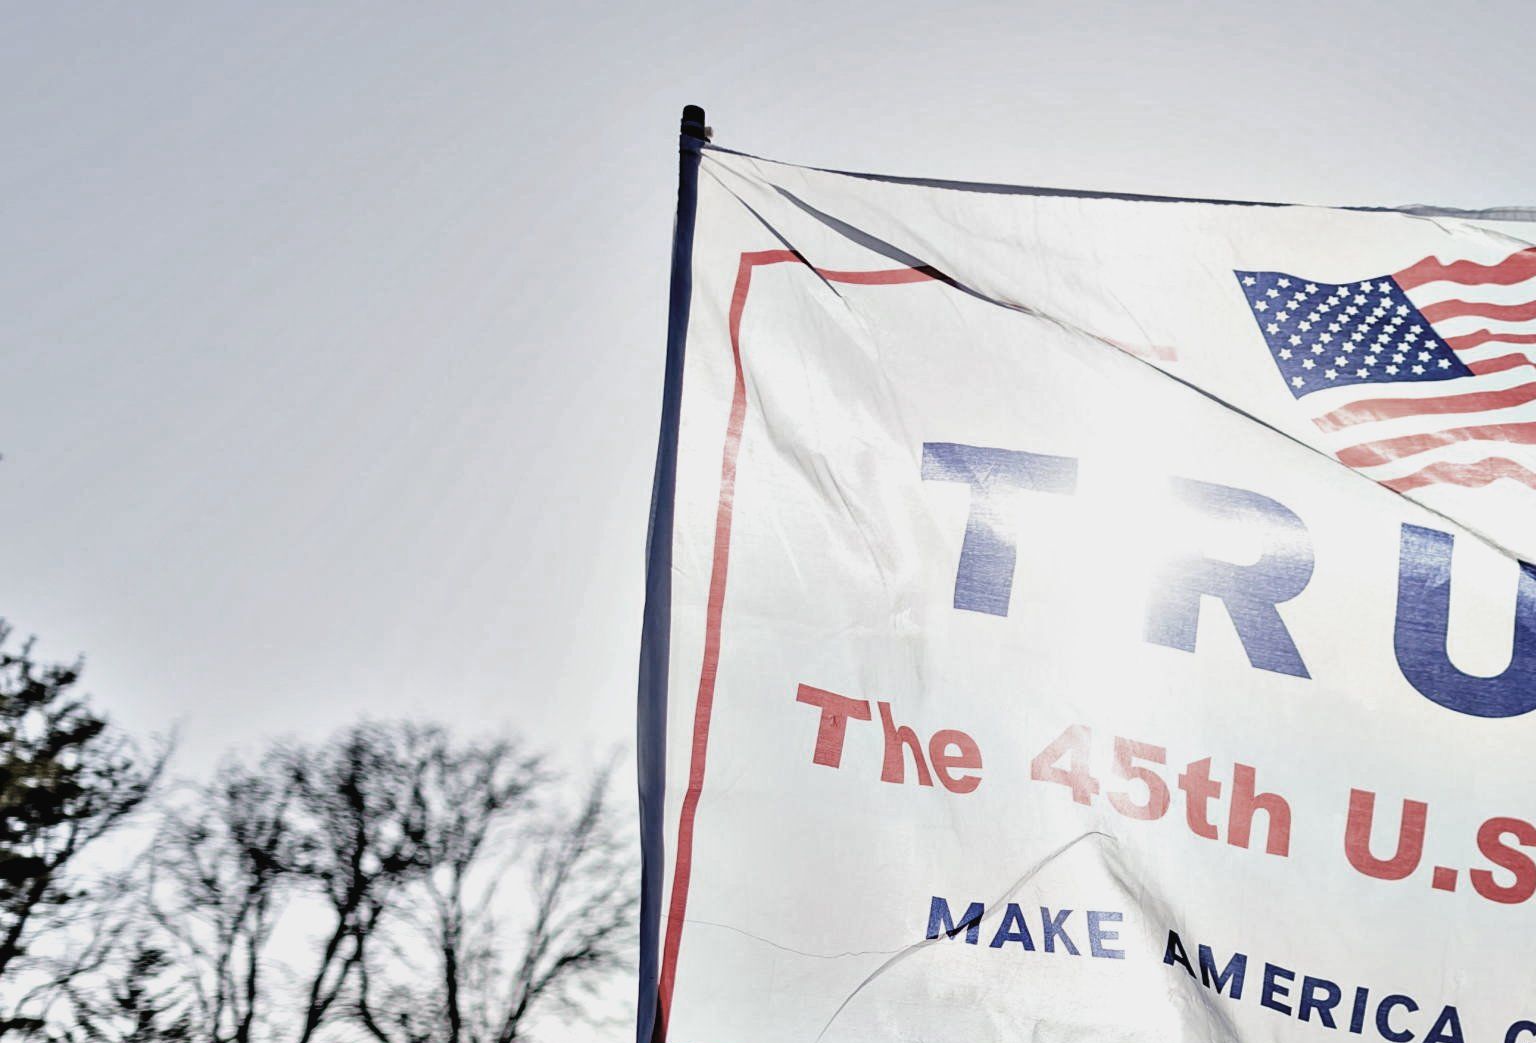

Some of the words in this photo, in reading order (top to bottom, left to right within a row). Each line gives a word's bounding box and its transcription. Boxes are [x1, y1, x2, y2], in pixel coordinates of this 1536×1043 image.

[796, 683, 983, 795] The
[1029, 724, 1292, 858] 45th
[925, 896, 1126, 960] MAKE
